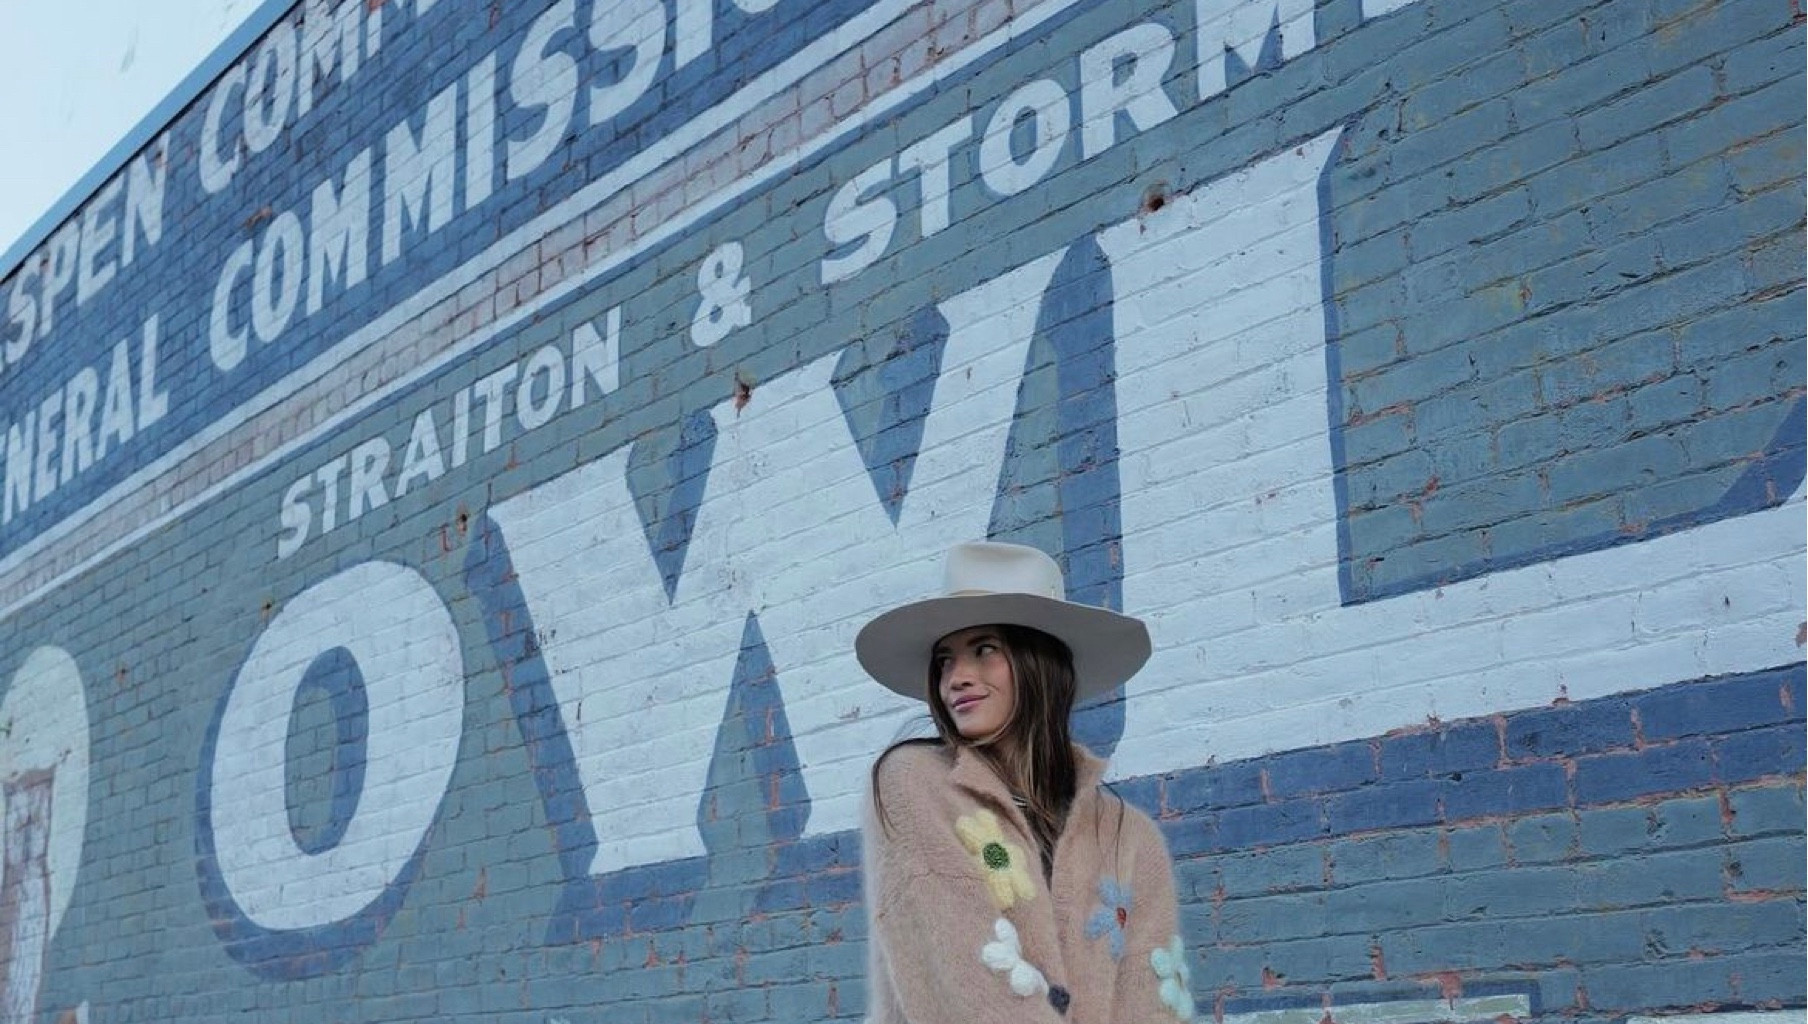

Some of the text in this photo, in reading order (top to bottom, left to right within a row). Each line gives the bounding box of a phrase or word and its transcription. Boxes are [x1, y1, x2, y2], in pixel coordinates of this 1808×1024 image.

[0, 130, 171, 374] SPEN
[0, 313, 169, 524] NERAL
[277, 0, 1420, 560] STRAITON & STORM
[209, 126, 1808, 931] OWL
